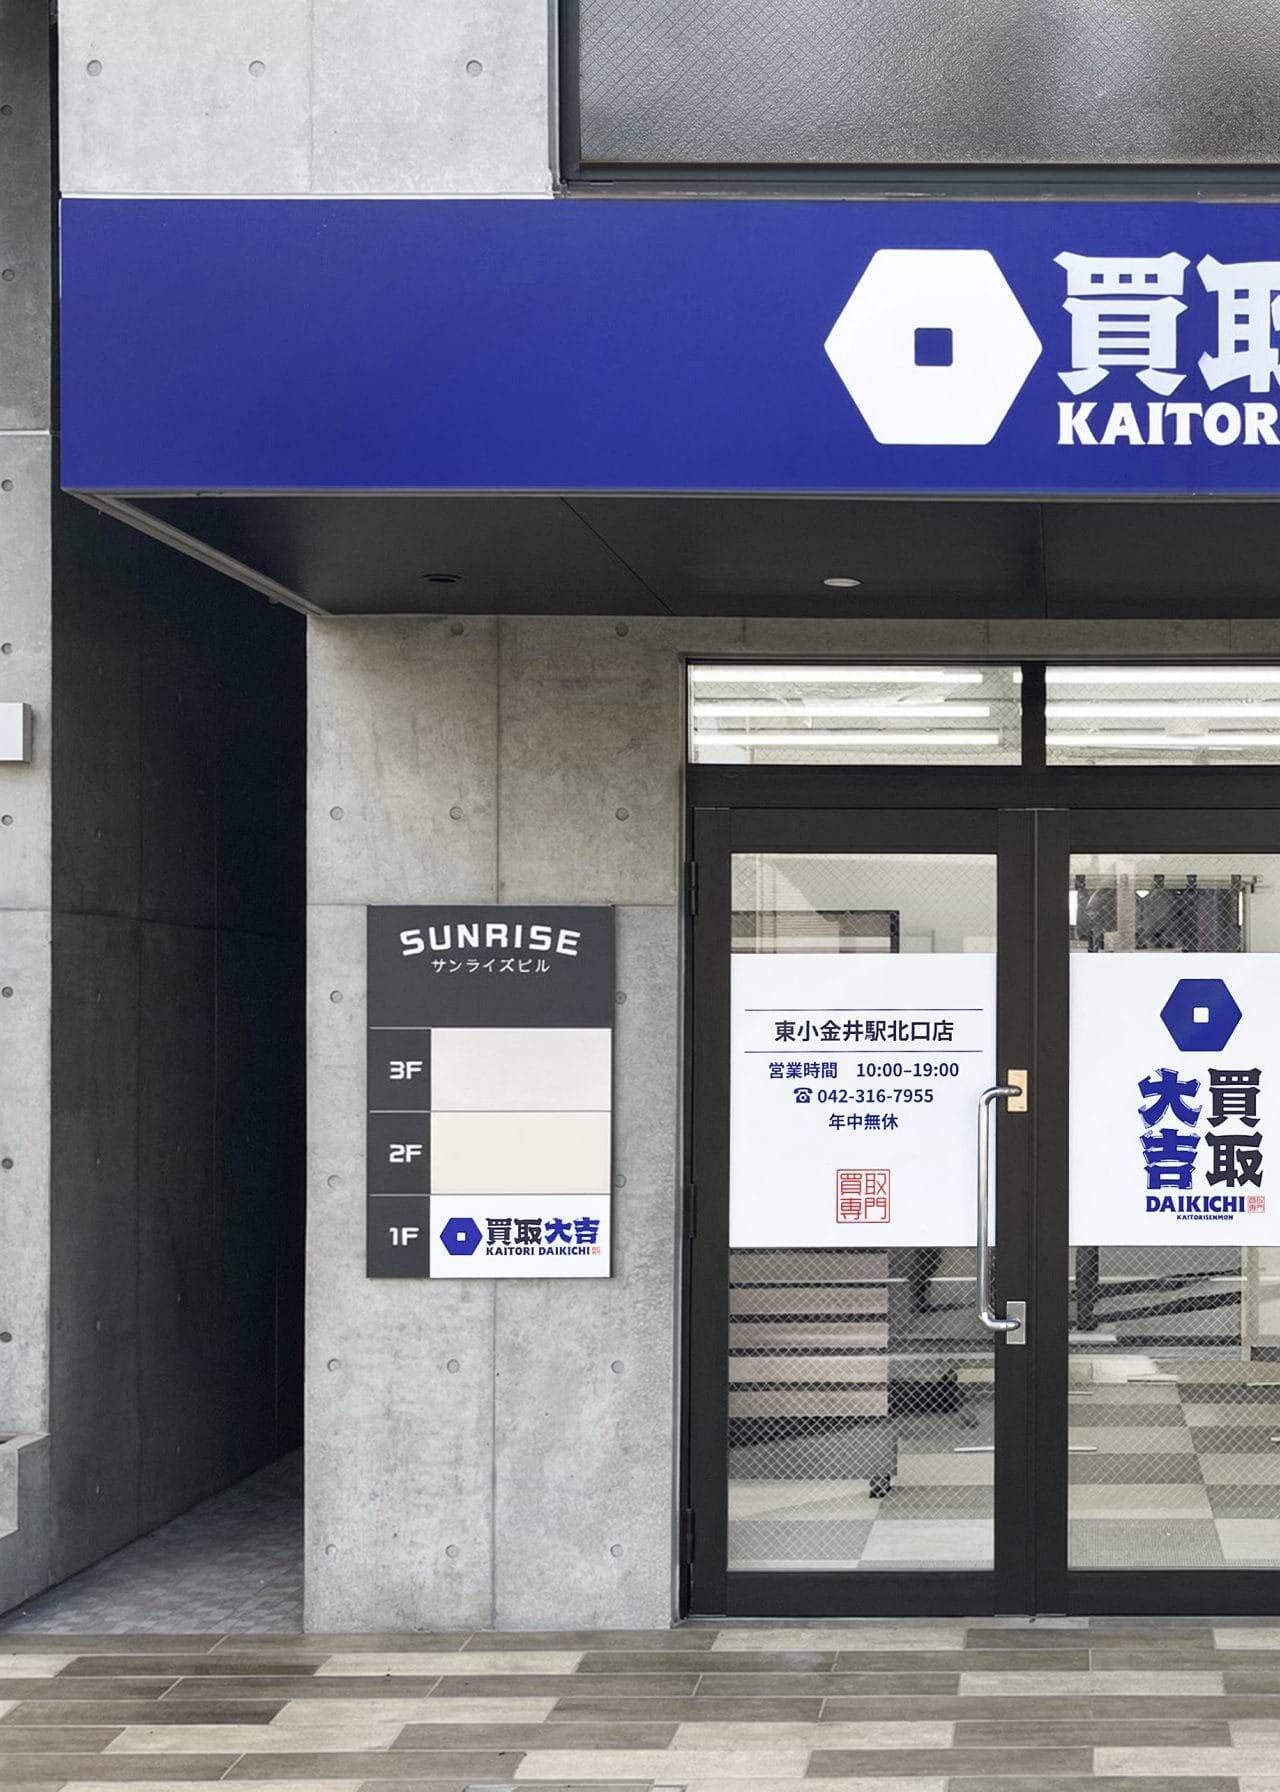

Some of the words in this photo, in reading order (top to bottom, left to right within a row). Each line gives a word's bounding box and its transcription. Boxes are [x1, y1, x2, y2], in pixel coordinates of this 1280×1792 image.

[400, 923, 581, 956] SUNRISE
[431, 958, 550, 974] サンライズビル
[774, 1019, 954, 1042] 東小金井駅北口店
[389, 1060, 423, 1080] 3F
[768, 1061, 838, 1079] 営業時間
[817, 1088, 934, 1104] 042-316-7955
[828, 1112, 899, 1131] 年中無休
[1137, 1067, 1203, 1190] 大吉
[1205, 1067, 1264, 1188] 買取
[389, 1143, 423, 1163] 2F
[1145, 1195, 1246, 1213] DAIKICHI
[389, 1227, 420, 1246] 1F
[485, 1217, 600, 1246] 買取大吉
[486, 1246, 535, 1256] KAITORI
[538, 1246, 590, 1256] DAIKICHI
